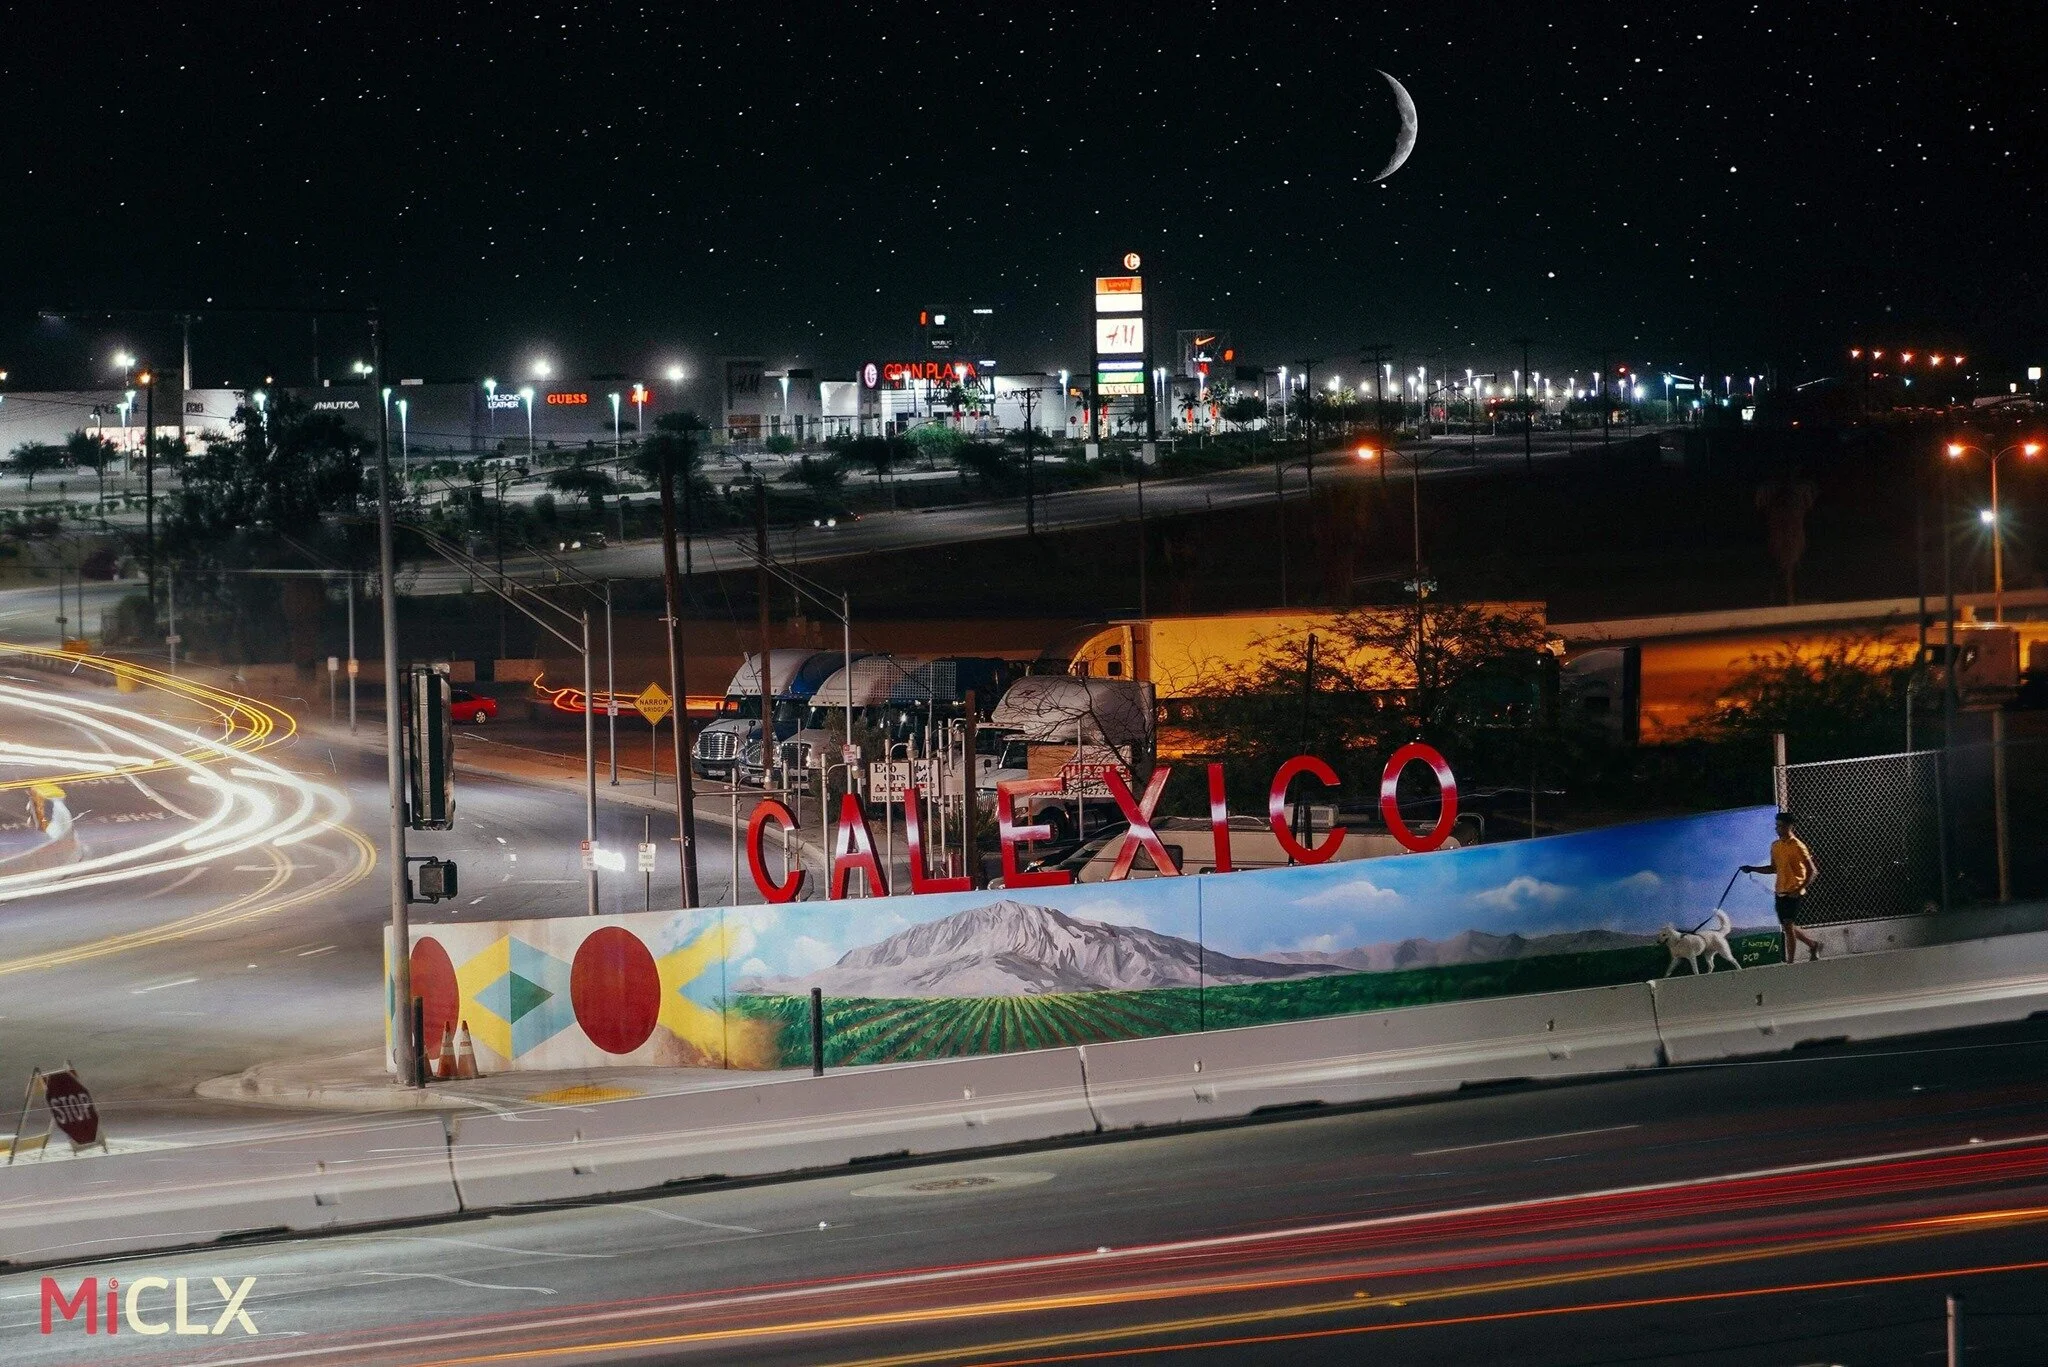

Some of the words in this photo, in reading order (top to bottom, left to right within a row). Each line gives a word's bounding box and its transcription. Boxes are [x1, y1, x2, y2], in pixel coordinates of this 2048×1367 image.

[883, 363, 923, 380] GRAN
[319, 401, 360, 410] NAUTICA
[488, 401, 518, 409] LEATHER
[547, 393, 588, 405] GUESS
[747, 742, 1459, 904] CALEXICO
[50, 1093, 92, 1124] STOP
